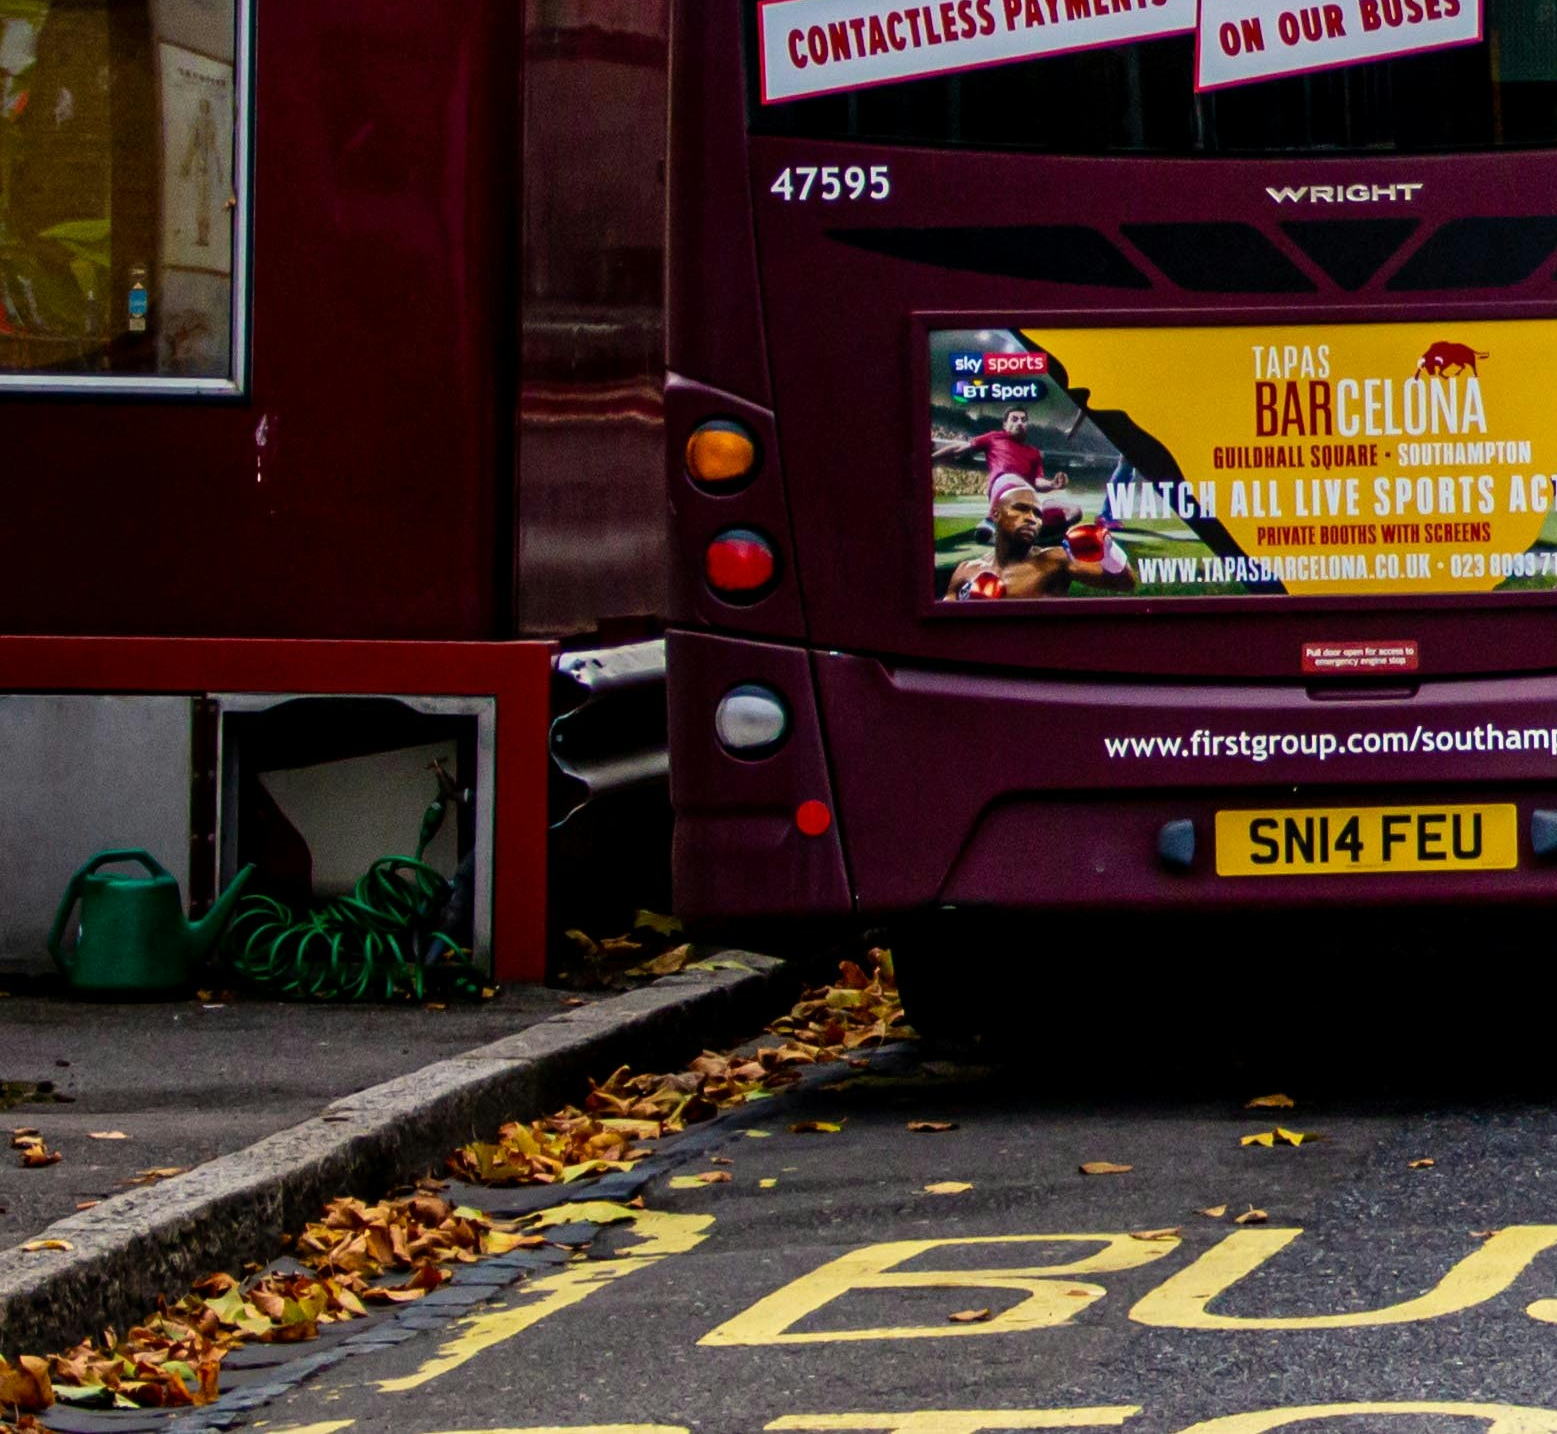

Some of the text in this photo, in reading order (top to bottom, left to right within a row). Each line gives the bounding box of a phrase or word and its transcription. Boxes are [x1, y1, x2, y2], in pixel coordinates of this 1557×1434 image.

[1219, 16, 1266, 58] ON
[1278, 2, 1347, 48] OUR
[770, 166, 892, 202] 47595
[1264, 182, 1423, 205] WRIGHT
[954, 353, 1046, 375] sky sports
[1251, 344, 1331, 380] TAPAS
[962, 381, 1039, 402] BT Sport
[1255, 377, 1489, 439] BARCELONA
[1213, 440, 1532, 471] GUILDHALL SQUARE SOUTHAMPTON
[1106, 479, 1218, 521] WATCH
[1230, 478, 1283, 519] ALL
[1294, 477, 1361, 518] LIVE
[1373, 474, 1496, 516] SPORTS
[1256, 522, 1491, 547] PRIVATE BOOTHS WITH SCREENS
[1137, 552, 1432, 584] WWW.TAPASBARCELONA.CO.UK
[1450, 554, 1485, 579] 023
[1489, 553, 1537, 578] 8033
[1248, 812, 1483, 865] SN14 FEU
